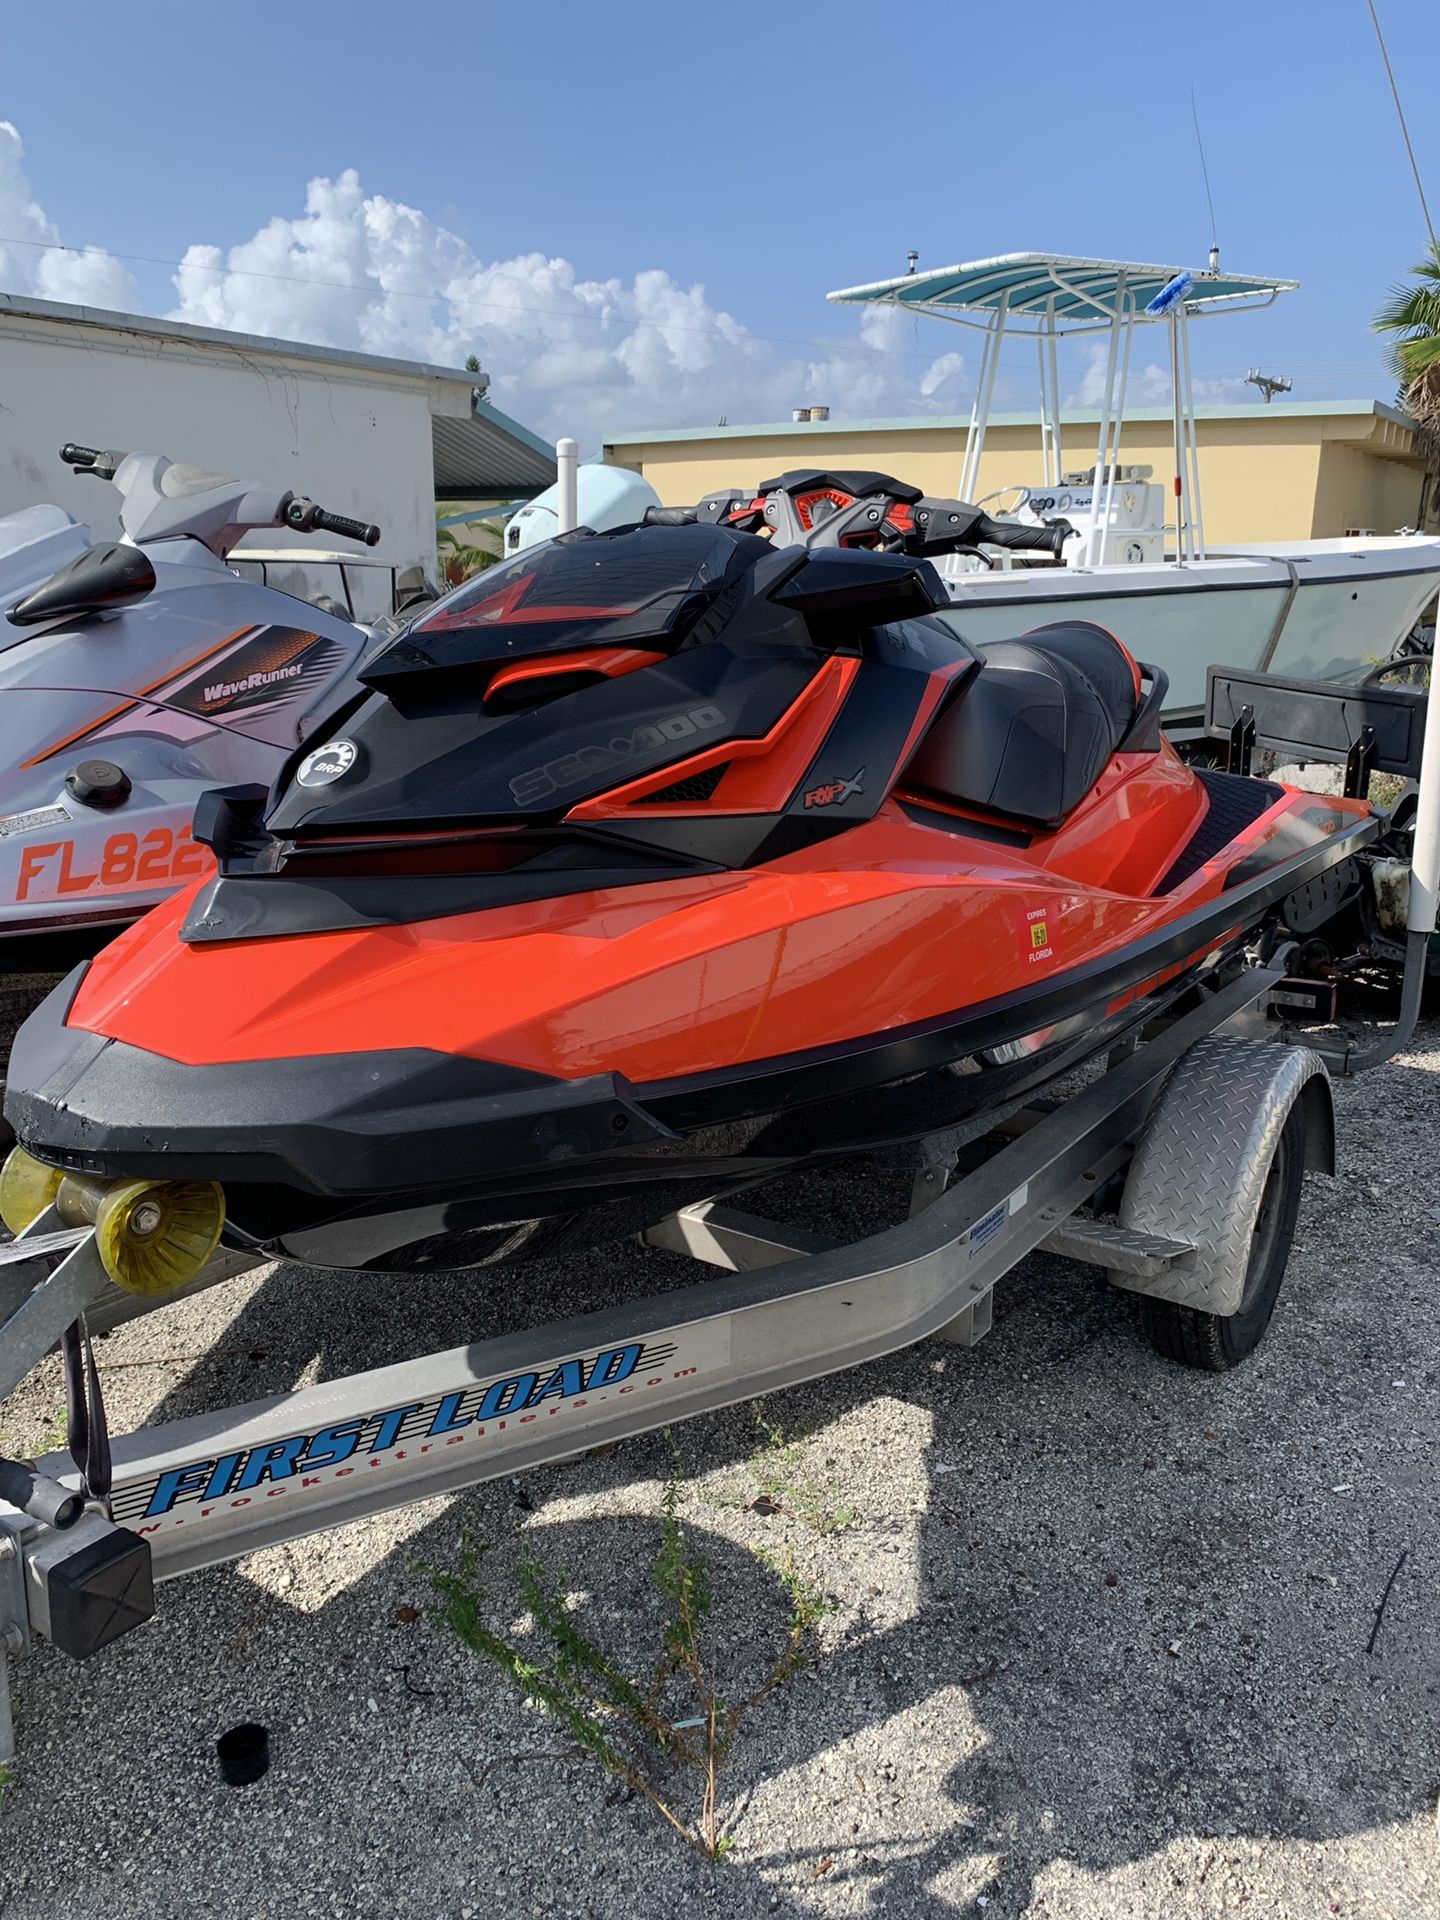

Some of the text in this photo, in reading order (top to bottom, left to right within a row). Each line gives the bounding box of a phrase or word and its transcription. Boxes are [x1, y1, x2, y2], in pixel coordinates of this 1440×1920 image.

[203, 663, 303, 702] WaveRunner
[314, 762, 344, 773] BRP
[16, 823, 217, 900] FL822
[1026, 908, 1047, 920] EXPIRES
[1028, 947, 1054, 963] FLORIDA
[140, 1343, 647, 1519] FIRST LOAD
